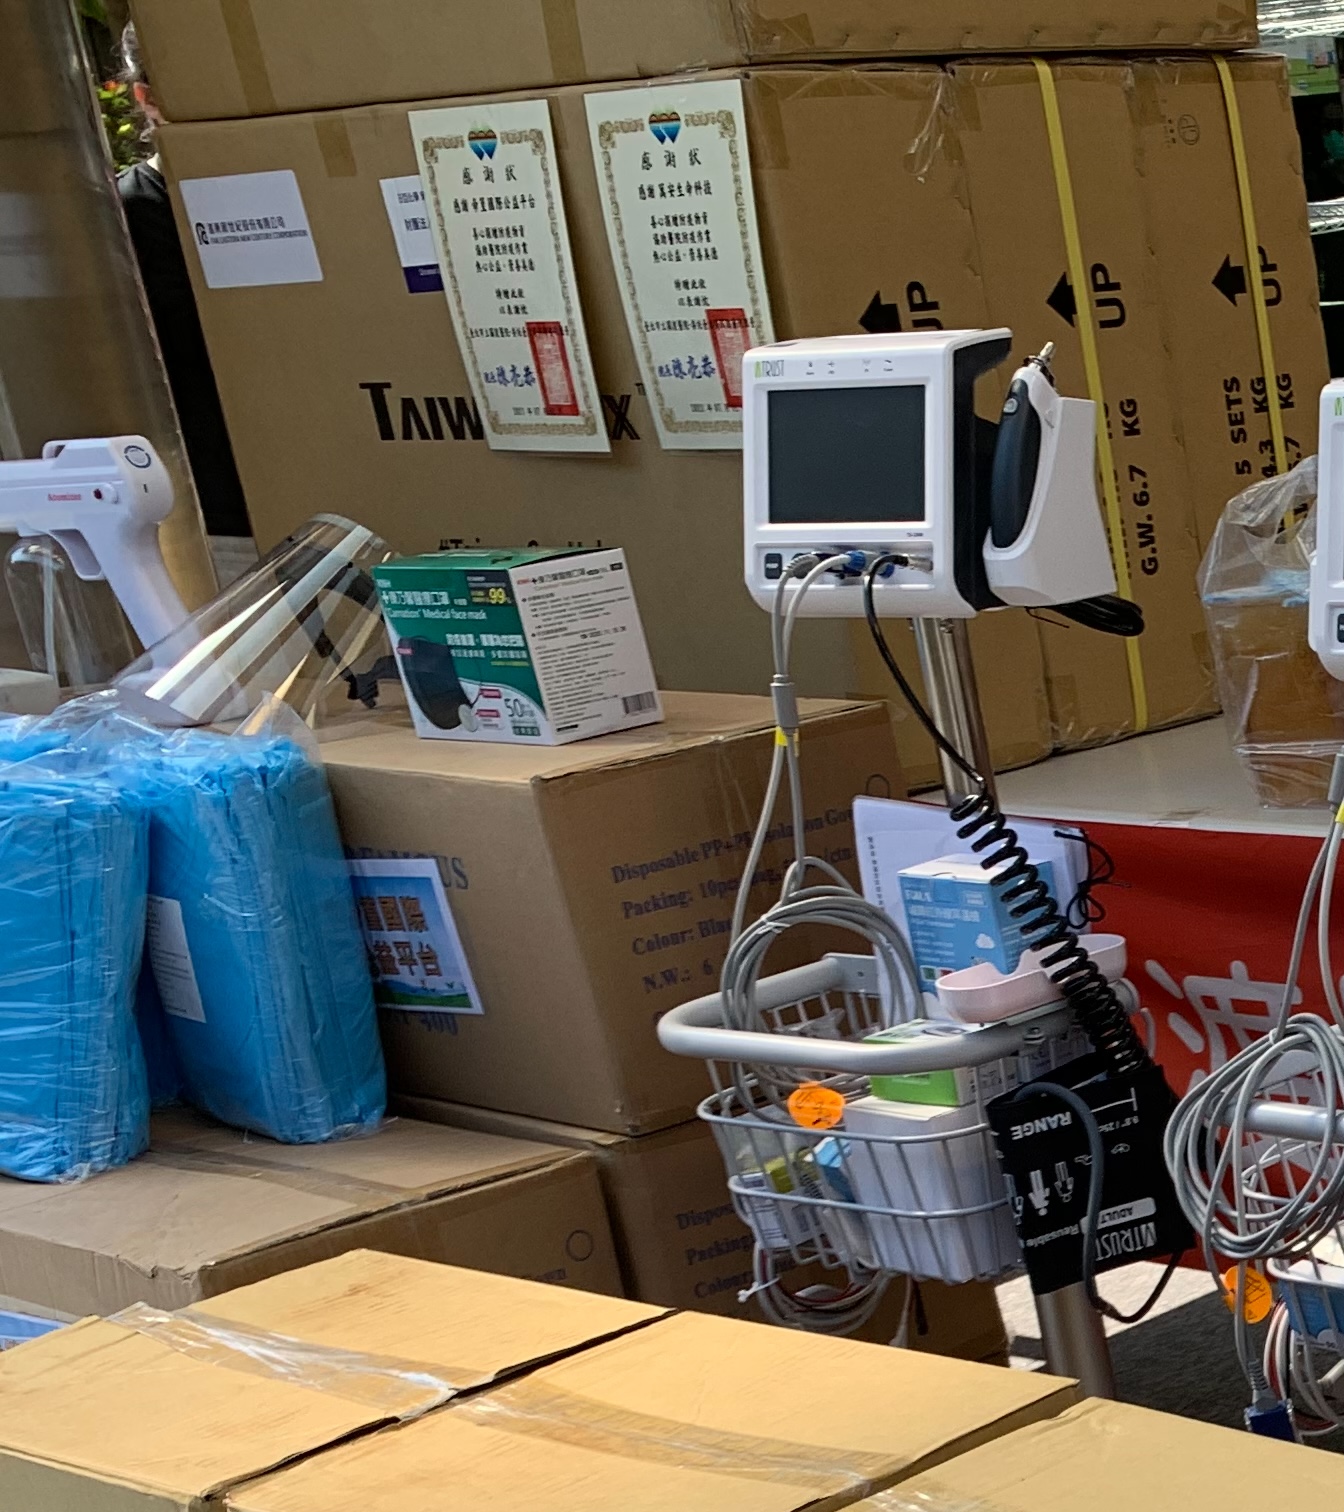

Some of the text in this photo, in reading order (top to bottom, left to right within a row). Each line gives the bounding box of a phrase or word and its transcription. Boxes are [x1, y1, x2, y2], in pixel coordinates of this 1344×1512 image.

[1089, 262, 1127, 330] UP
[1119, 397, 1141, 437] KG
[1223, 376, 1247, 444] SETS
[610, 847, 698, 884] Disposable
[1009, 1110, 1073, 1140] RANGE
[1100, 1206, 1134, 1224] ADULT
